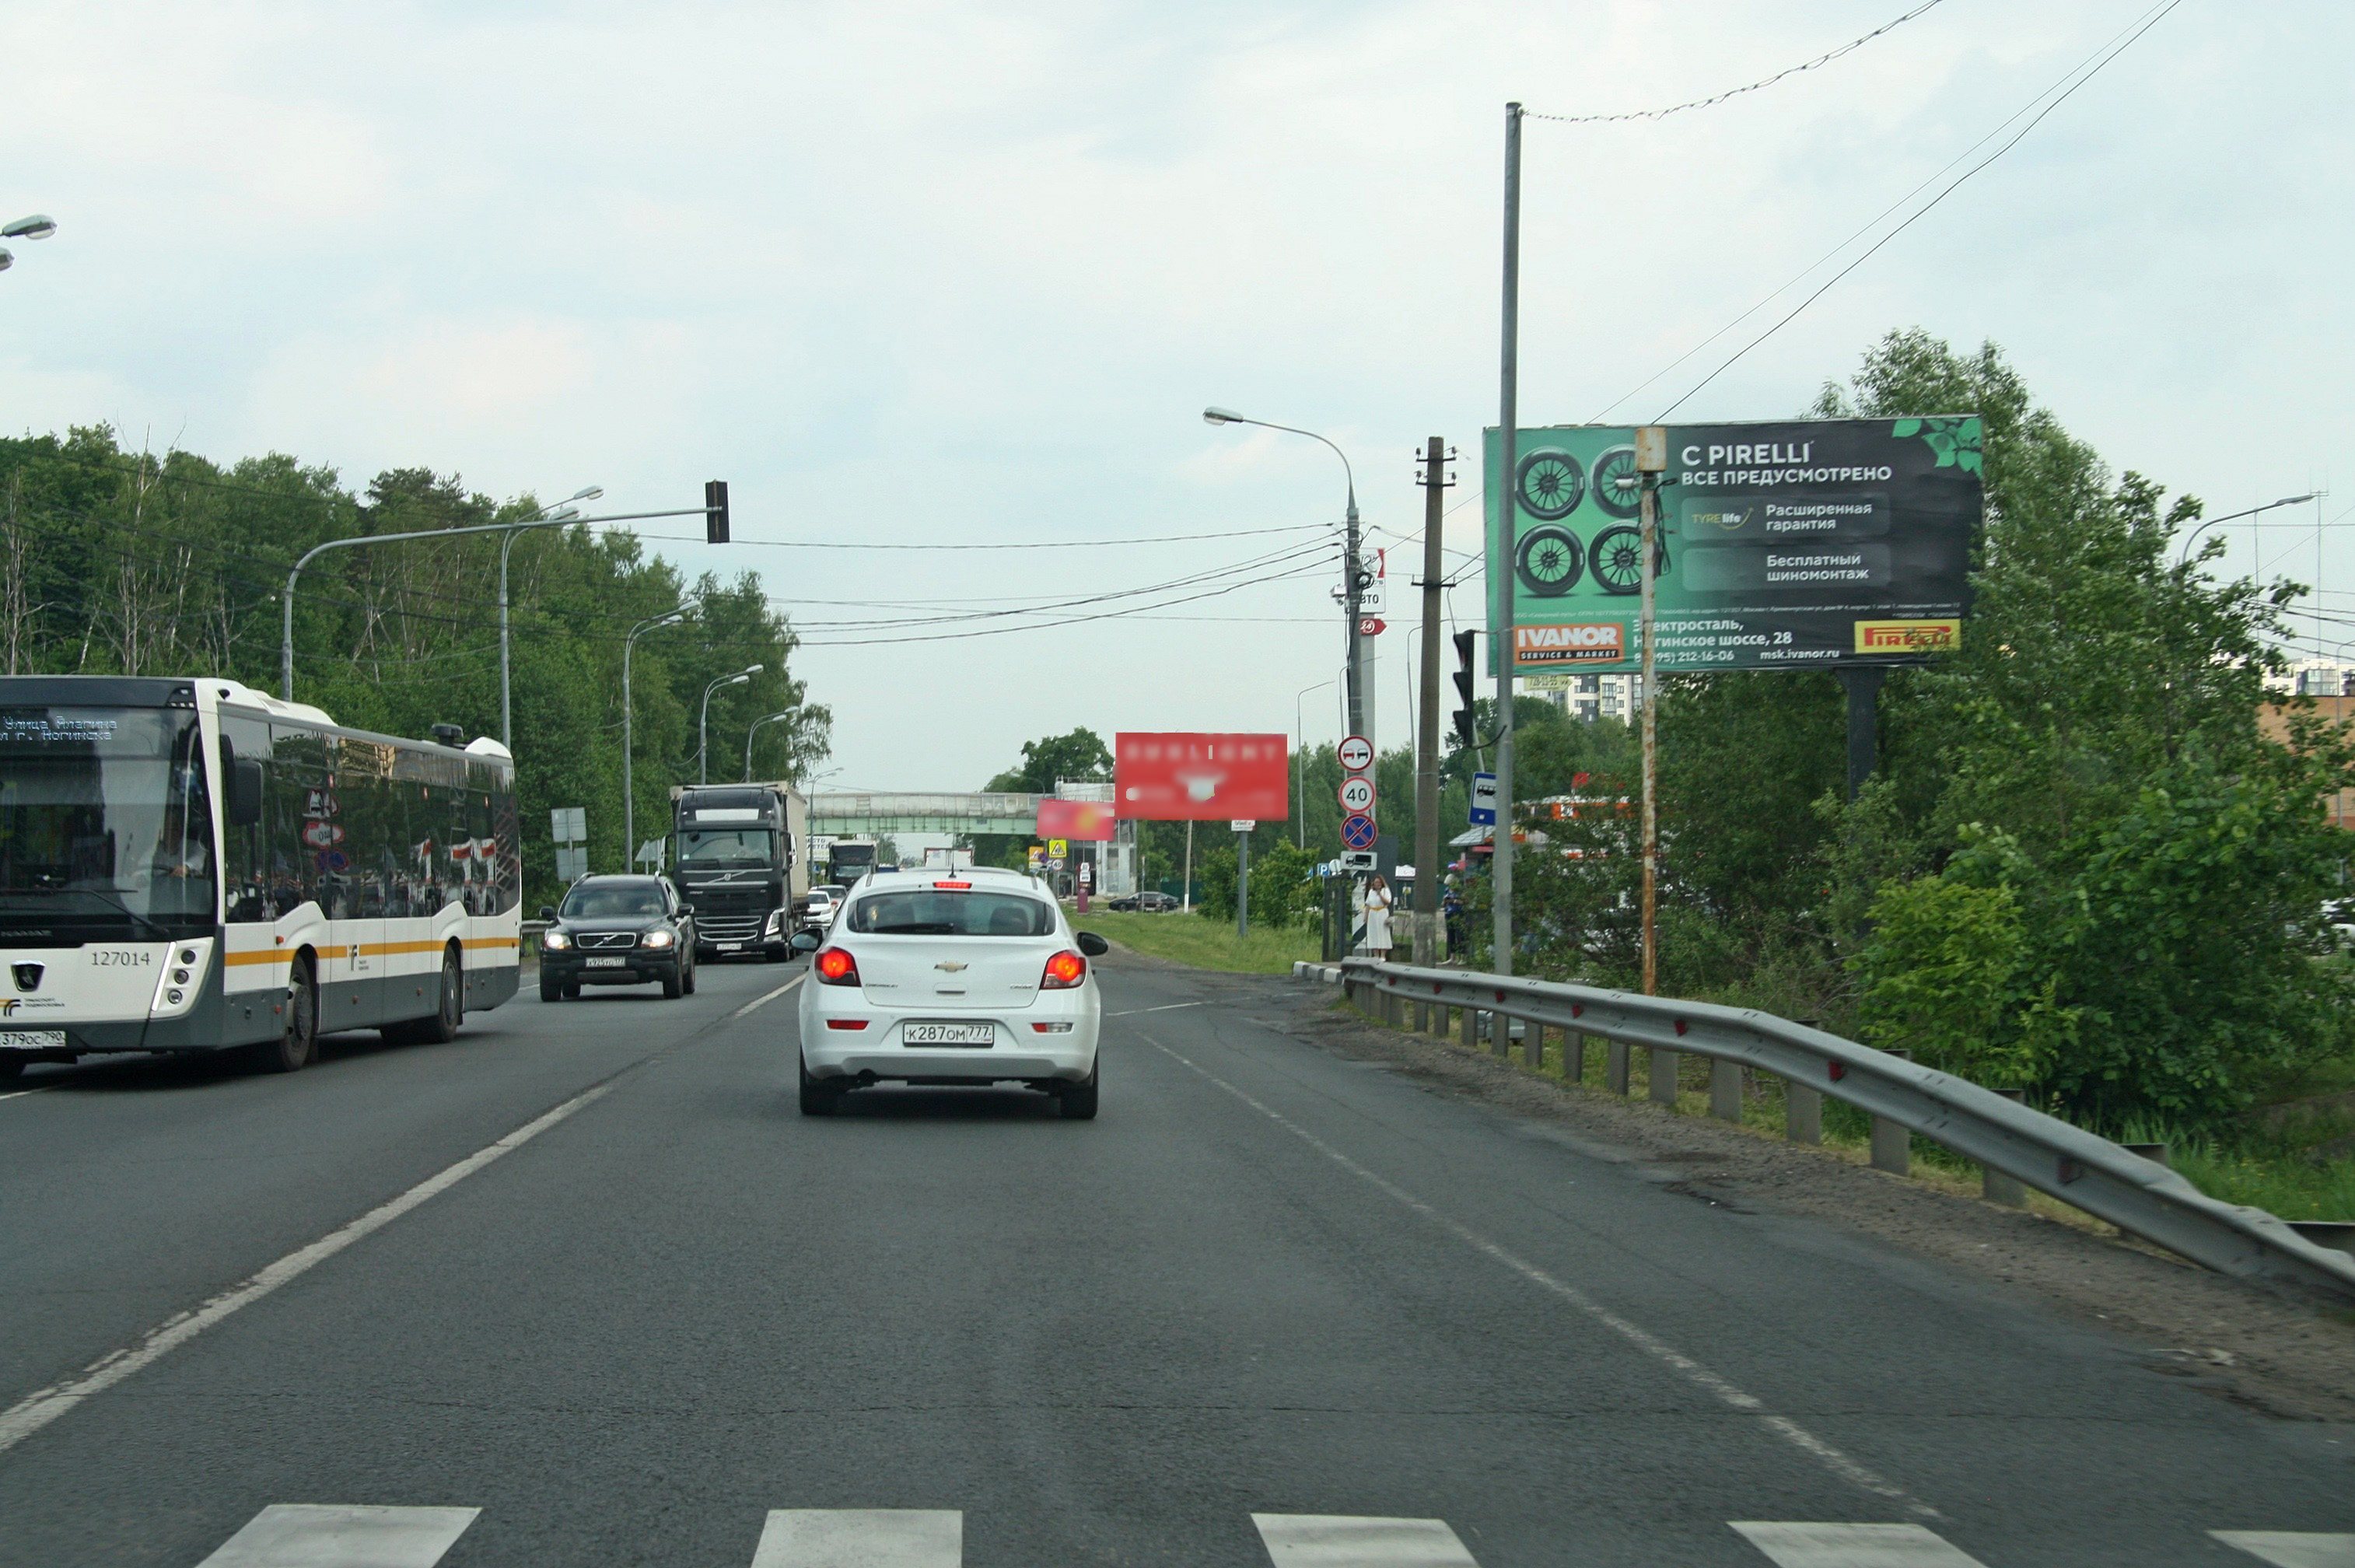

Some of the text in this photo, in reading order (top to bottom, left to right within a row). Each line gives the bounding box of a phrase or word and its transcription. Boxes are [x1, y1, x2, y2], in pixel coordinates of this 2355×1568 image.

[1709, 443, 1810, 466] PIRELLI
[1681, 466, 1891, 487] ВСЕ ПРЕДУСМОТРЕНО
[1766, 504, 1872, 518] Расширенная
[1766, 519, 1836, 533] гарантия
[1766, 553, 1861, 567] Бесплатный
[1767, 569, 1869, 582] шиномонтаж
[1632, 619, 1744, 635] Эектросталь,
[1518, 626, 1618, 647] IVANOR
[1633, 632, 1792, 648] Нгинское шоссе, 28
[1520, 652, 1562, 660] SERVICE
[1576, 649, 1617, 659] MARKET
[1678, 650, 1735, 663] 212-16-06
[1760, 649, 1840, 660] msk.ivanor.ru
[1346, 788, 1367, 802] 40
[92, 951, 150, 967] 127014
